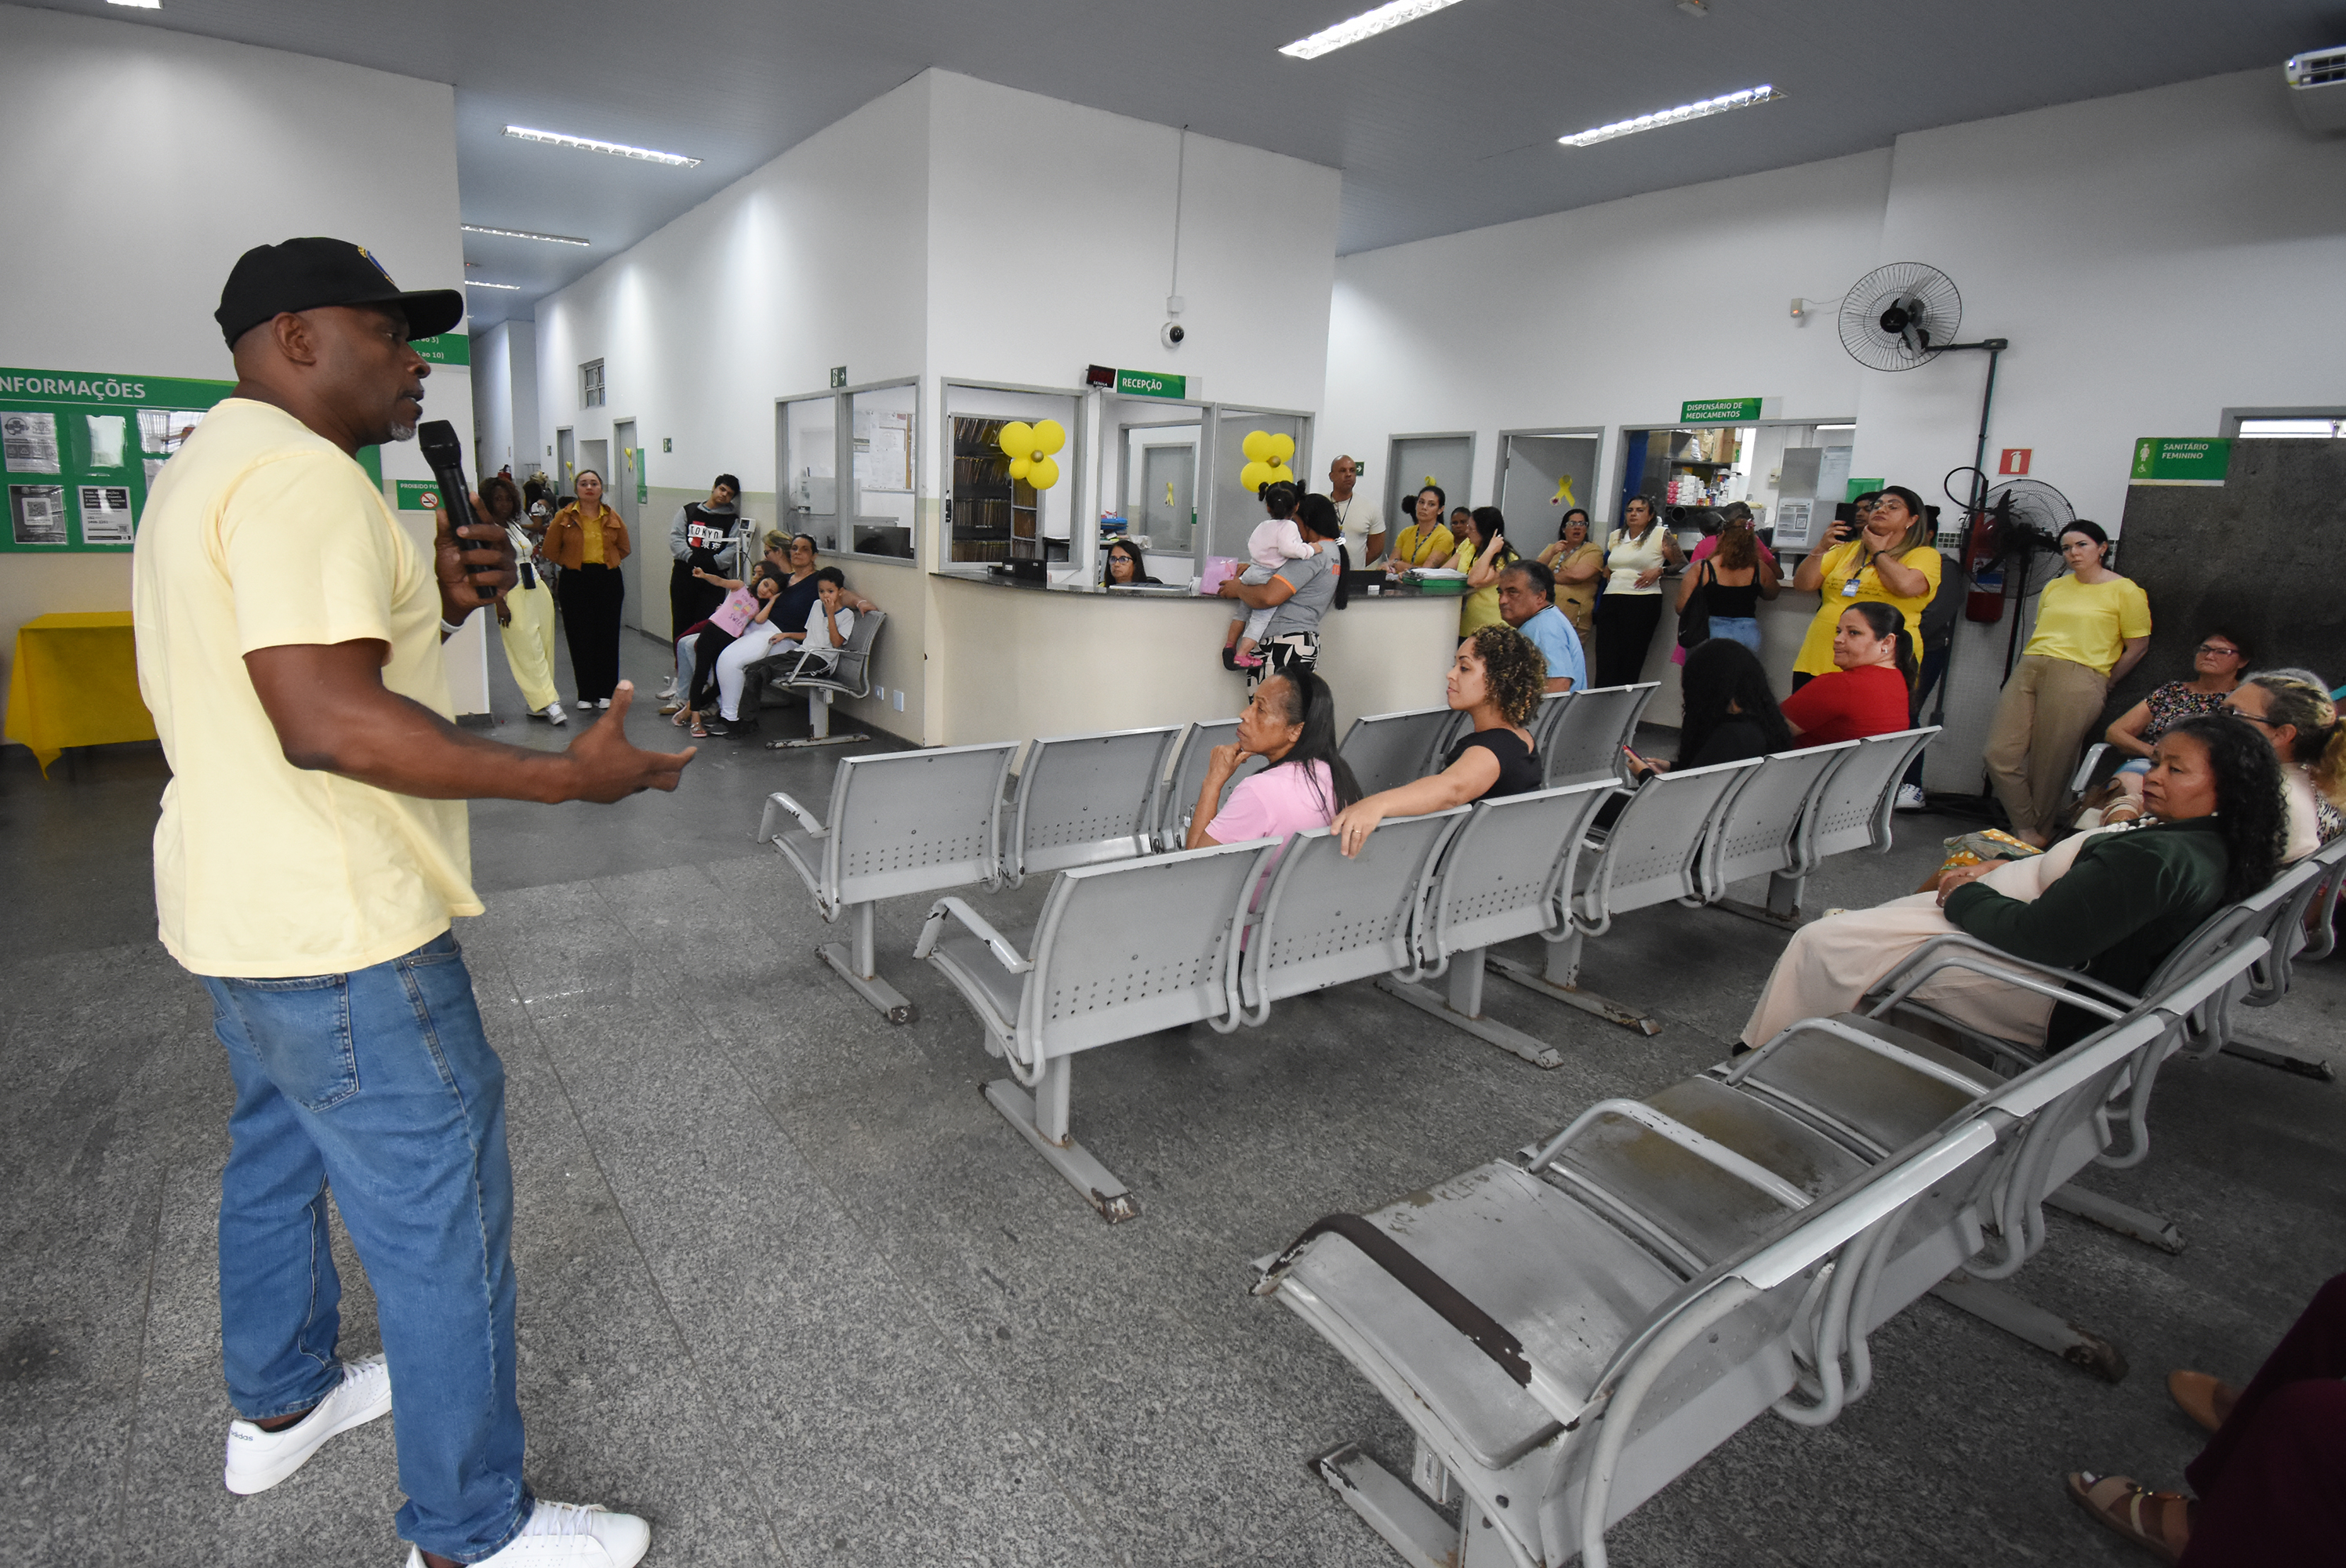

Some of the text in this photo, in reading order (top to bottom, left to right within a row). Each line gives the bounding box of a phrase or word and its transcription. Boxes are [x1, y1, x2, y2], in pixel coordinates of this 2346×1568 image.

[0, 376, 147, 401] NFORMAÇÕES
[1122, 378, 1163, 392] RECEPÇÃO
[1687, 402, 1730, 412] DISPENSÁRIO
[1686, 410, 1741, 419] MEDICAMENTOS
[2163, 442, 2209, 451] SANITÁRIO
[690, 526, 719, 539] TOKYO
